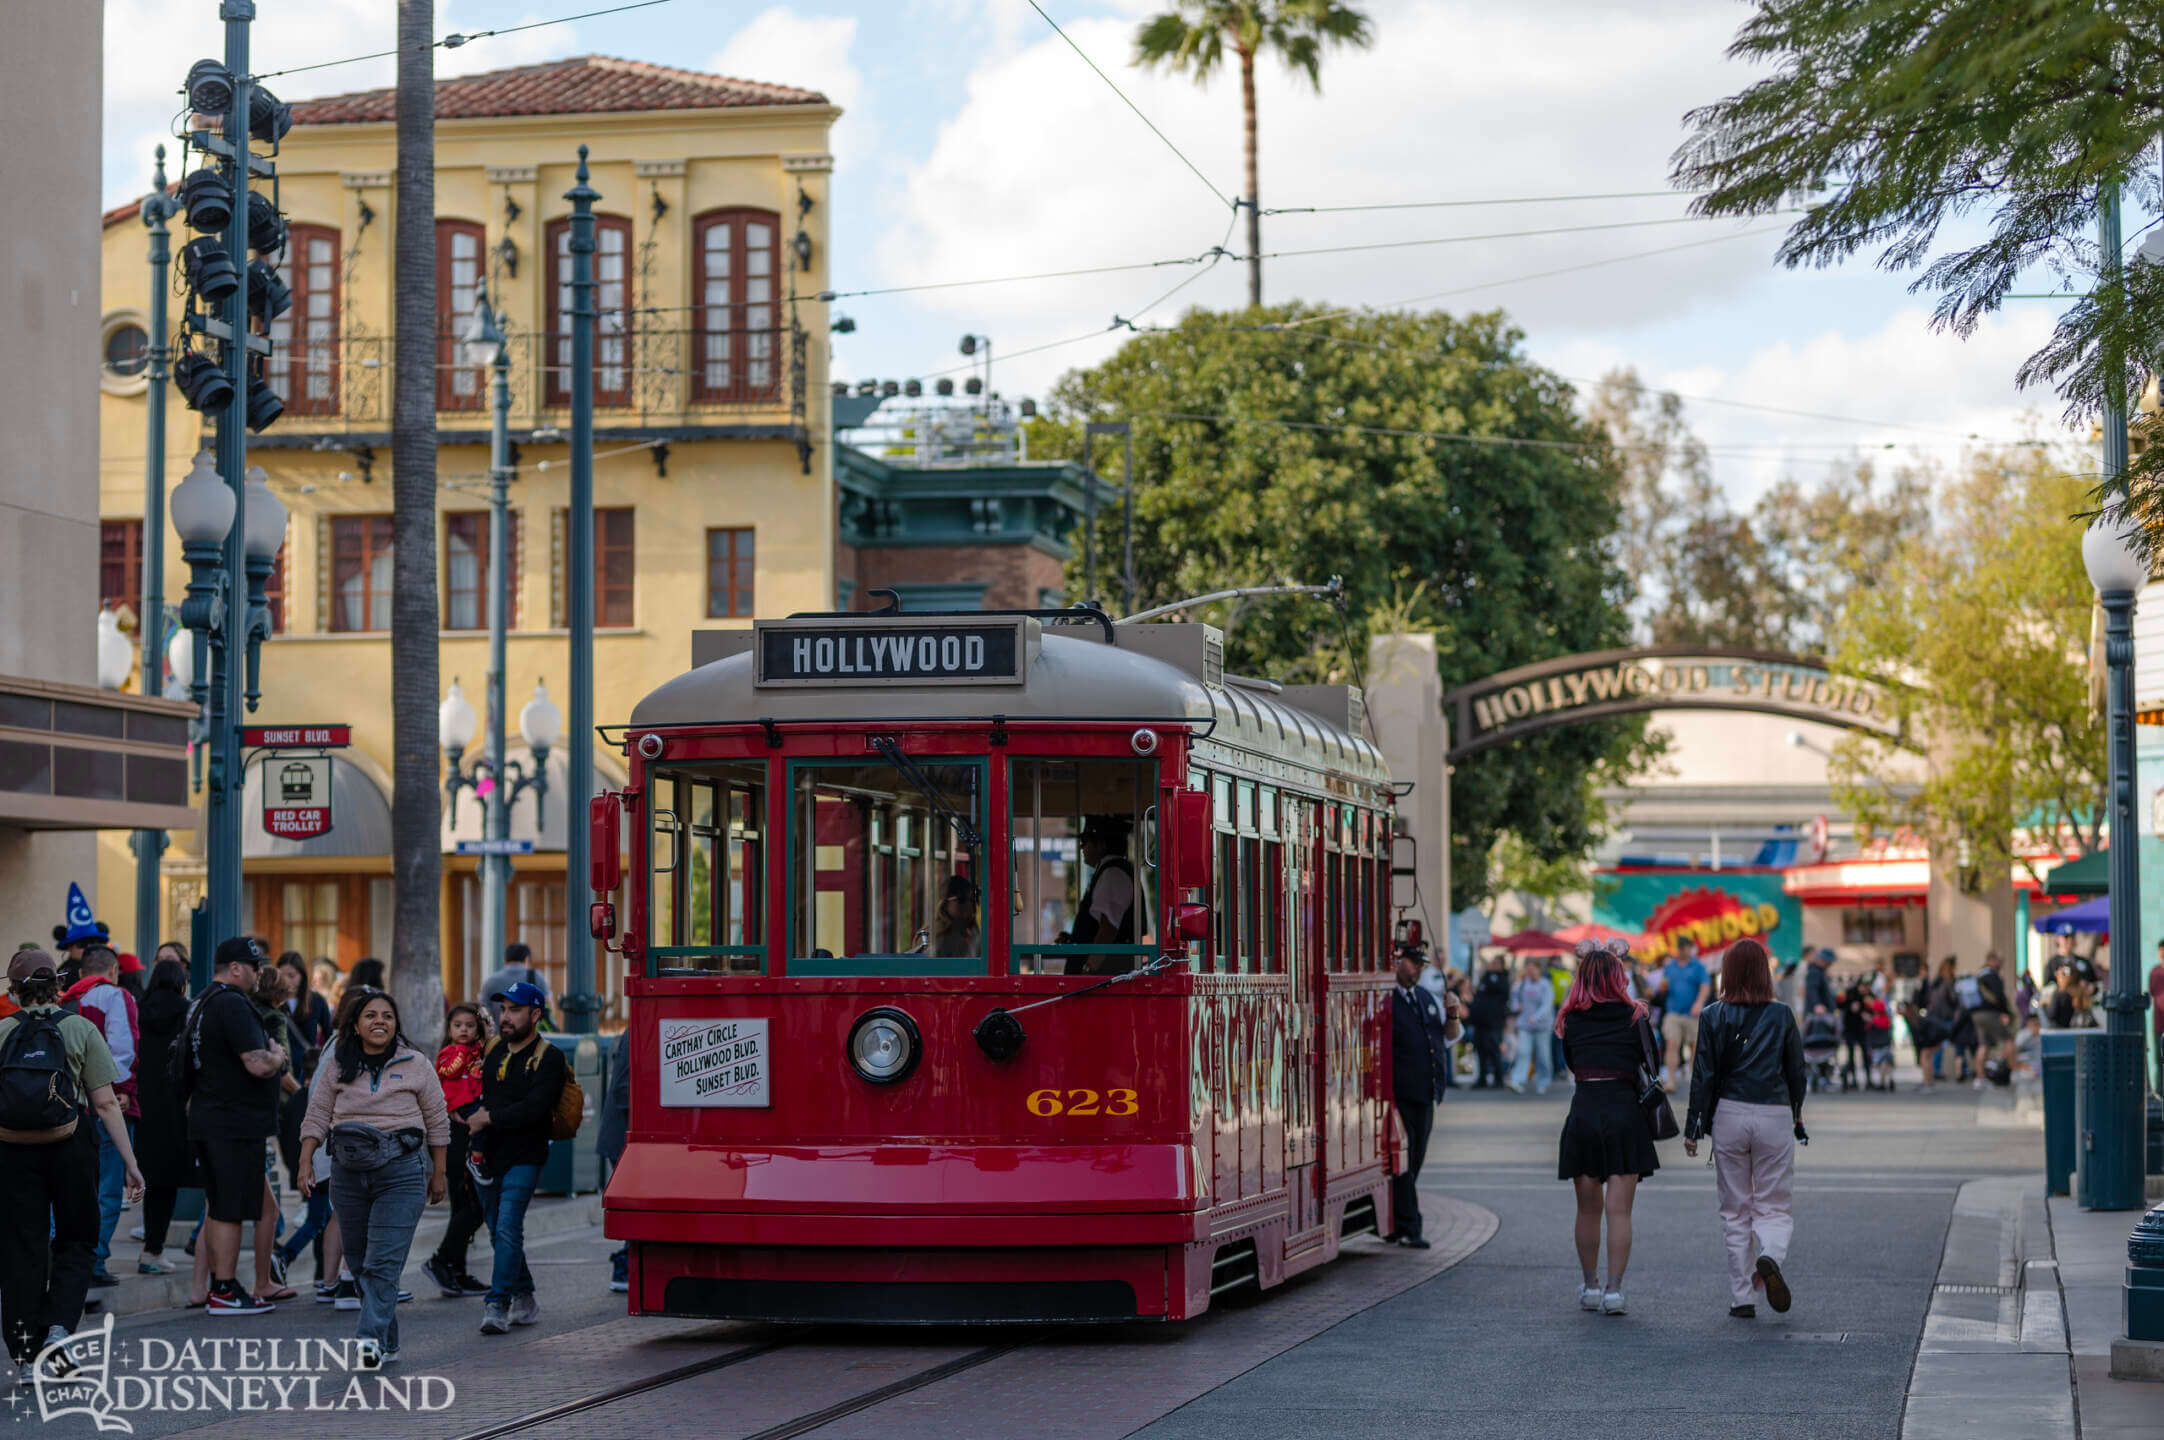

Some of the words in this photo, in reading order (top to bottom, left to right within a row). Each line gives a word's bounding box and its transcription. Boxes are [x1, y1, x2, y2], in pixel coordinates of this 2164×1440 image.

[793, 635, 984, 672] HOLLYWOOD
[1474, 663, 1709, 730] HOLLYWOOD
[264, 730, 299, 743] SUNSET
[305, 730, 331, 743] BLVD.
[272, 821, 322, 832] TROLLEY
[273, 811, 295, 821] RED
[299, 810, 320, 820] CAR
[665, 1034, 704, 1059] CARTHAY
[707, 1024, 738, 1046] CIRCLE
[677, 1048, 732, 1078] HOLLYWOOD
[734, 1040, 759, 1059] BLVD.
[696, 1070, 731, 1095] SUNSET
[734, 1062, 760, 1082] BLVD.
[1026, 1088, 1139, 1117] 623
